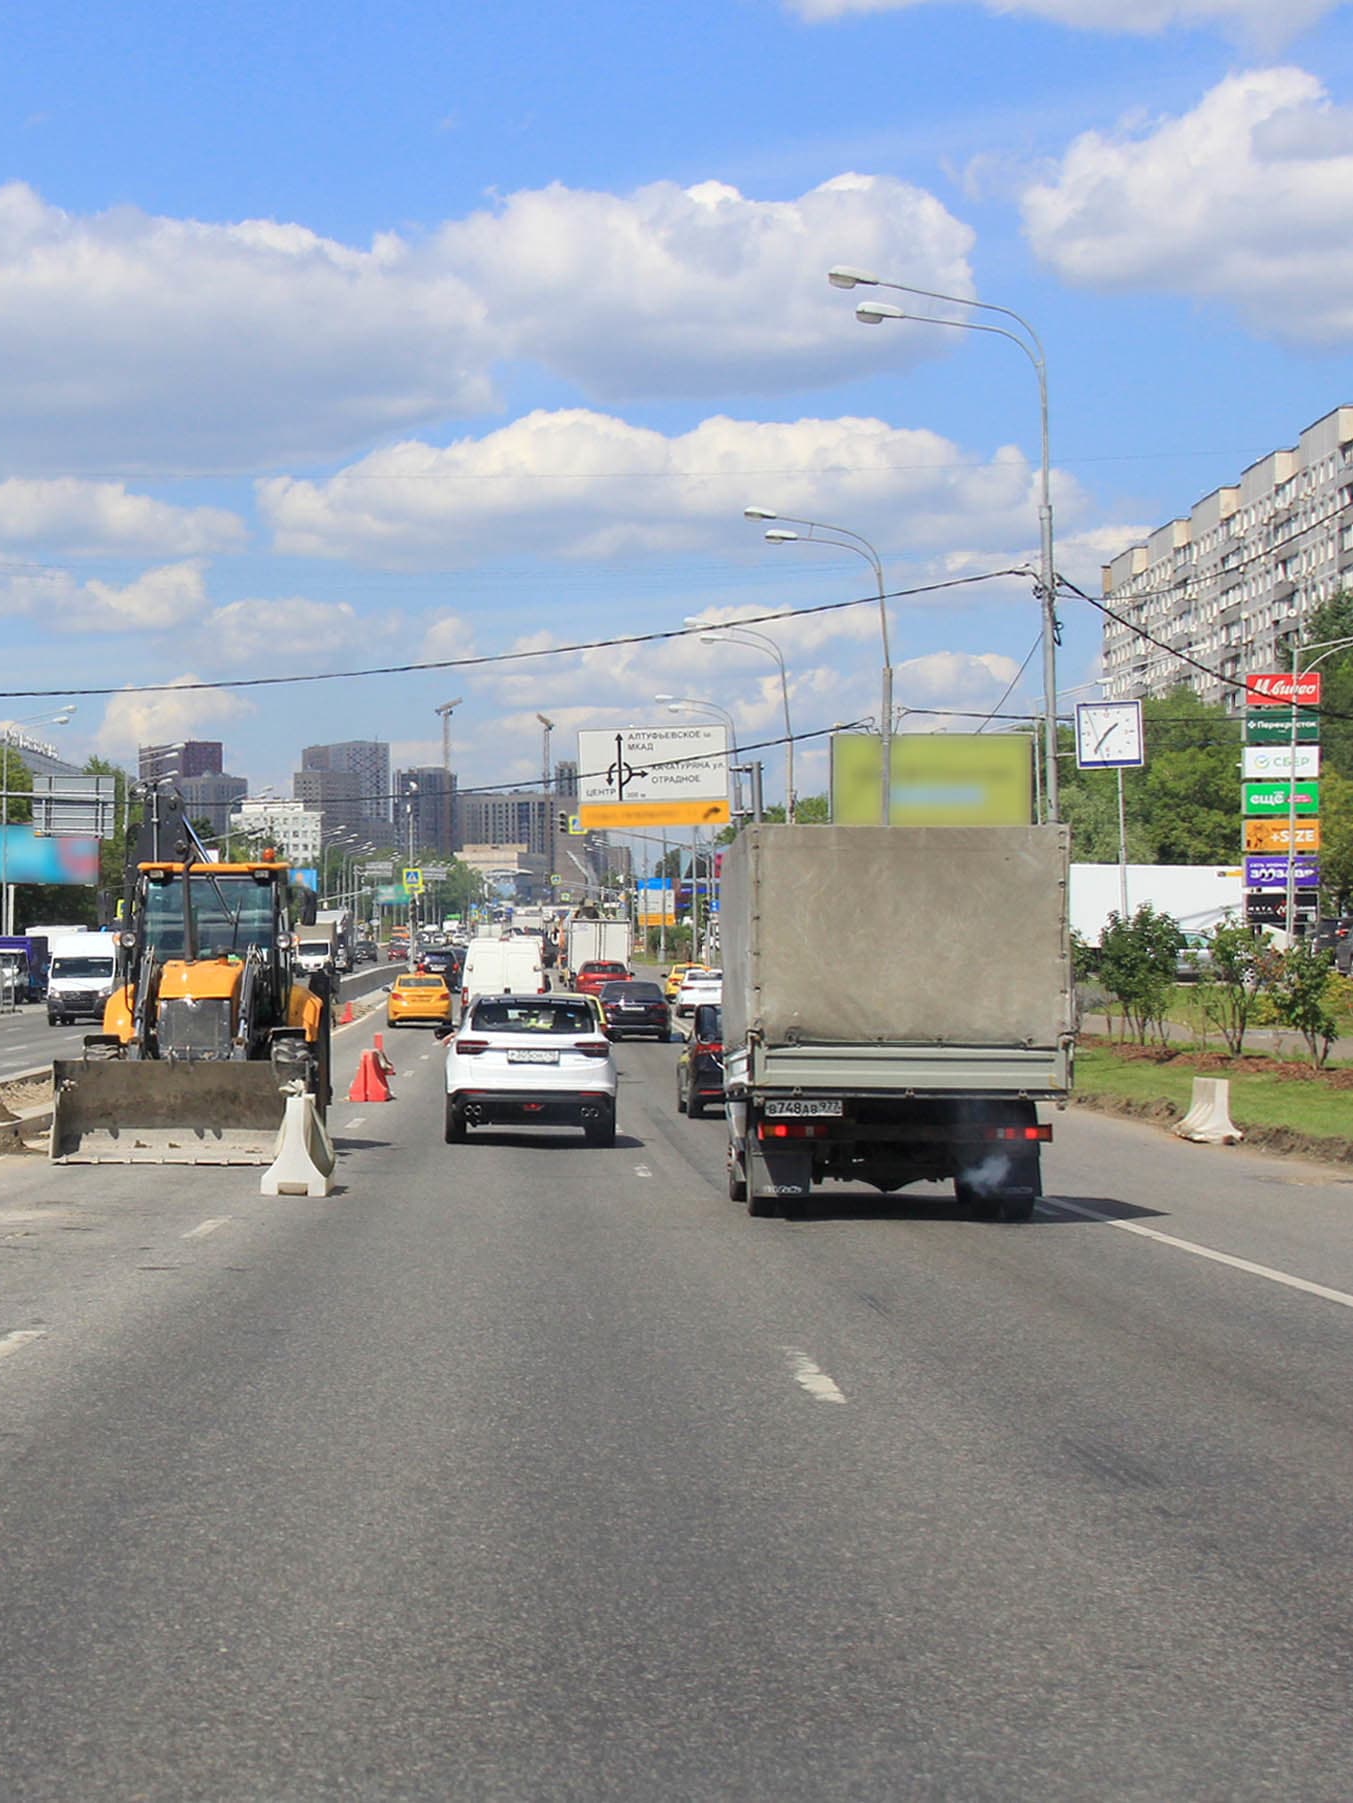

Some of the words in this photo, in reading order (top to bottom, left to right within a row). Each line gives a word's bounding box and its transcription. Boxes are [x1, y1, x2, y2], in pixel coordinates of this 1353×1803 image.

[1257, 720, 1316, 730] Перекрсток
[628, 730, 701, 741] АЛТУФЬЕВСКОЕ
[628, 743, 654, 751] МКАД
[651, 775, 701, 784] ОТРАДНОЕ
[586, 788, 617, 797] ЦЕНТР
[1271, 829, 1315, 843] +SZE
